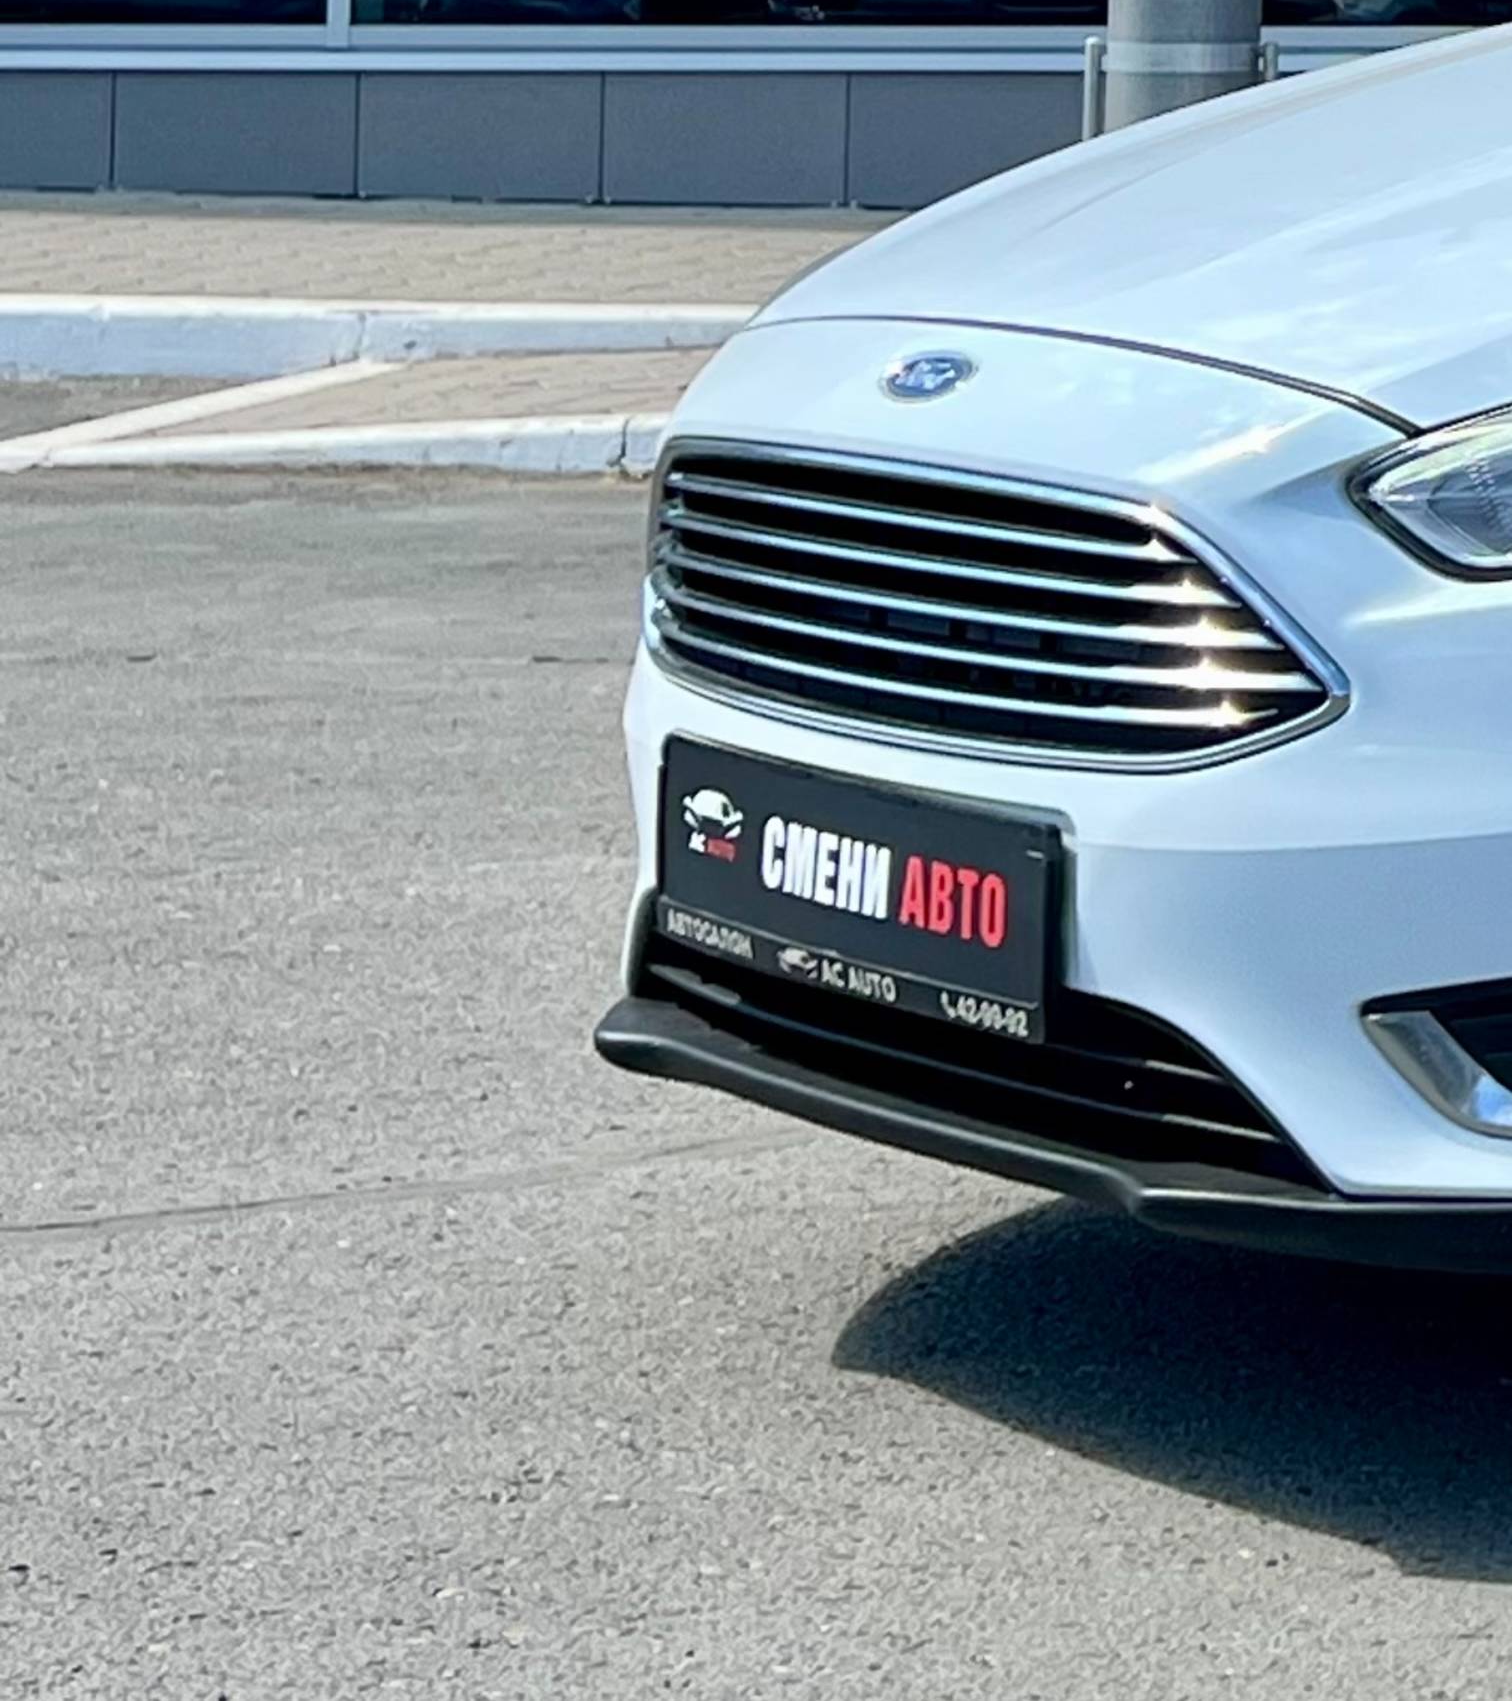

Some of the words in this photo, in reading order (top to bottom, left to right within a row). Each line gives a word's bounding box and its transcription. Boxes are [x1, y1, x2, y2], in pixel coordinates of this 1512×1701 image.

[761, 815, 892, 921] СМЕНИ
[899, 855, 1006, 948] АВТО
[848, 965, 897, 1003] AUTO
